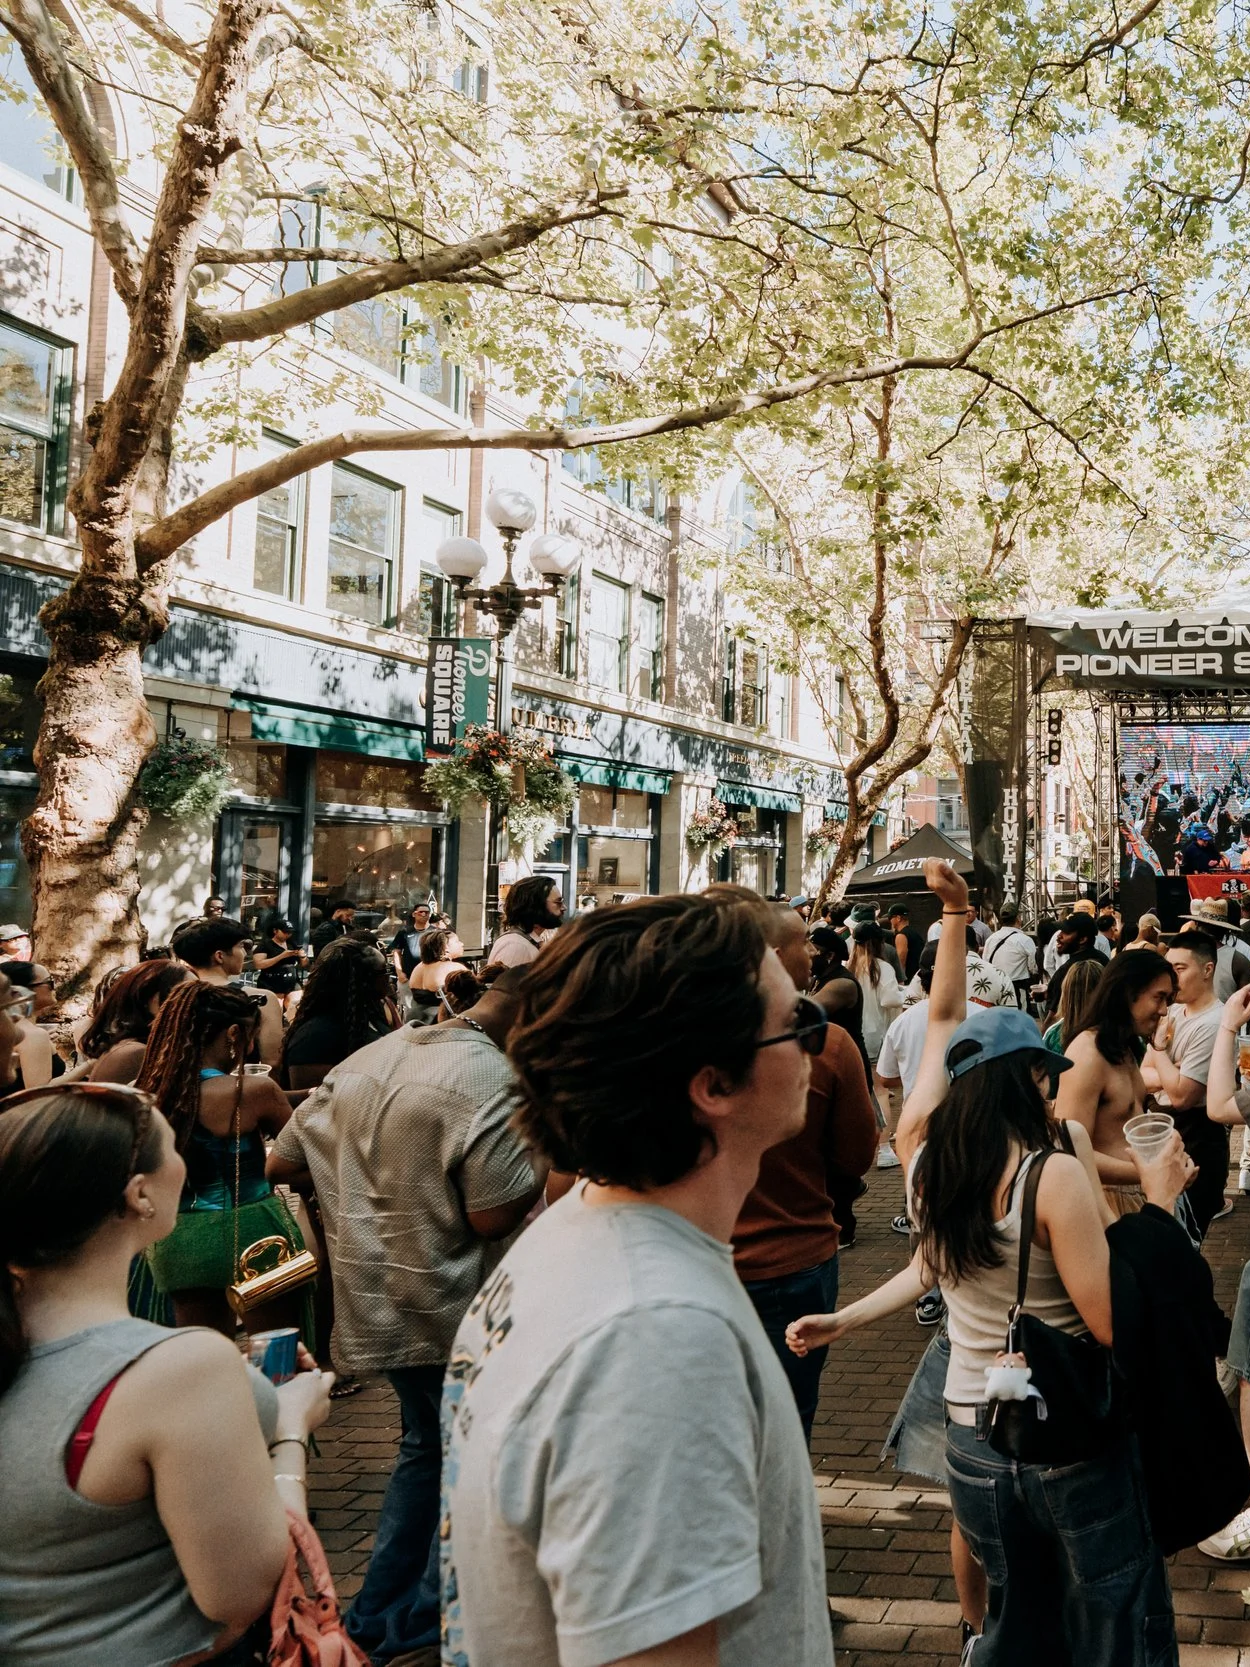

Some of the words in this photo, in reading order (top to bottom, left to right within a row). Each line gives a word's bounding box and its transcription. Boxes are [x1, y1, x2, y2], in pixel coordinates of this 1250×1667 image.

[1055, 652, 1223, 677] PIONEER
[431, 644, 453, 745] SQUARE
[451, 644, 490, 725] Pioneer
[511, 707, 593, 740] UMBRIA
[1001, 788, 1019, 904] HOMETEA
[873, 857, 956, 877] HOMETM
[1221, 880, 1248, 893] R&B
